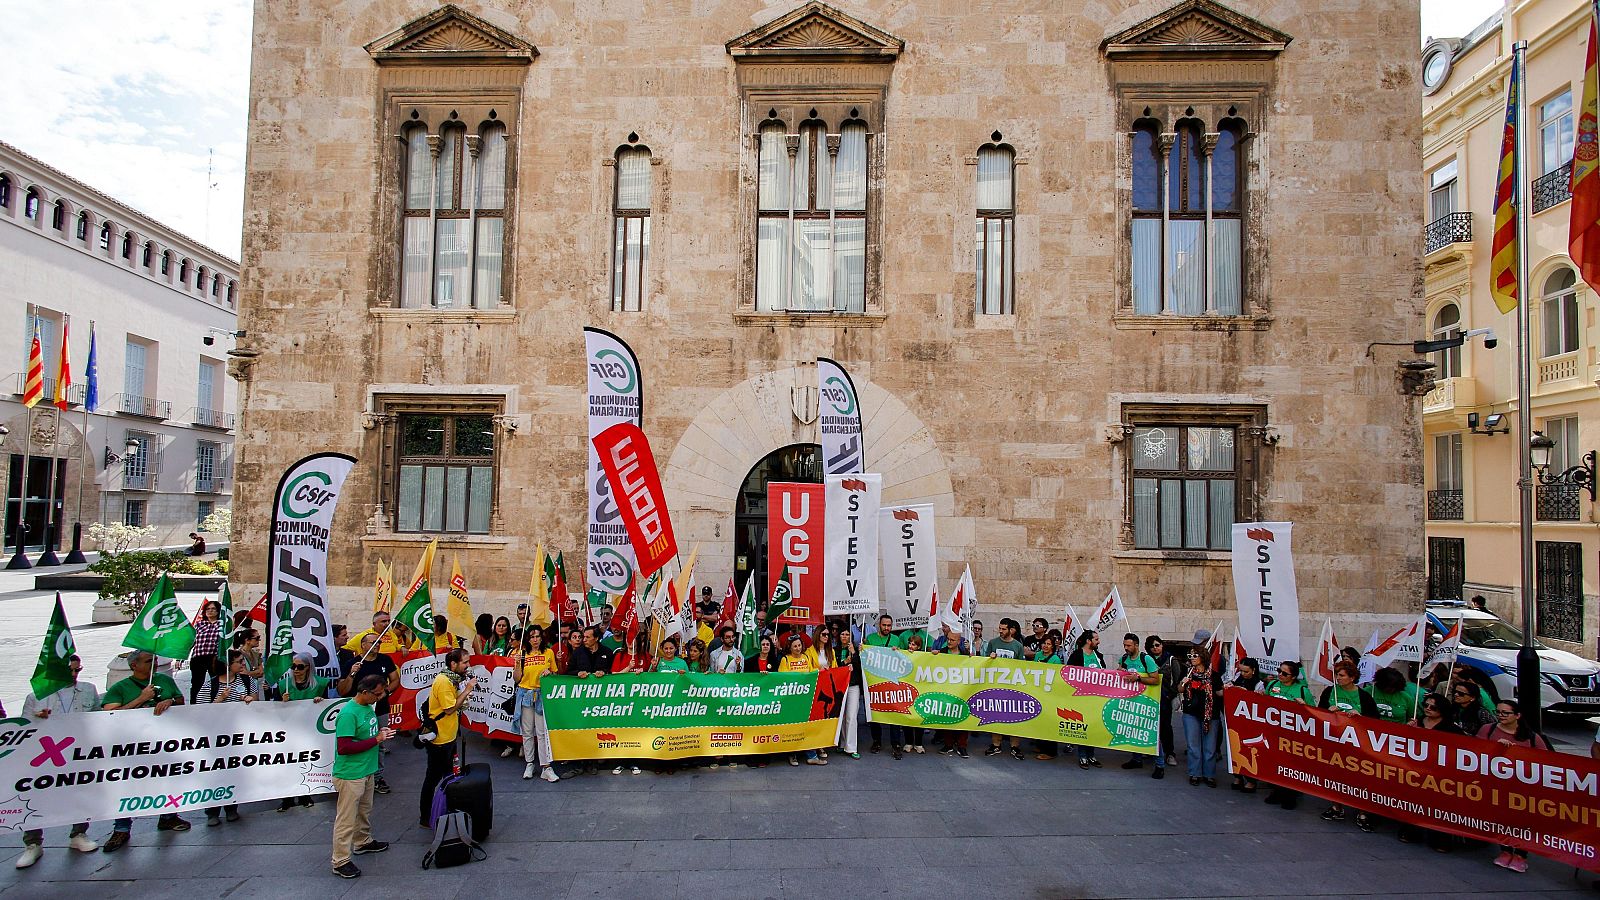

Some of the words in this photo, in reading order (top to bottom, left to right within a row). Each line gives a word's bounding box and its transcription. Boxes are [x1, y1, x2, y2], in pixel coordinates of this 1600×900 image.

[295, 485, 335, 507] CSIF
[610, 436, 662, 545] CCOO
[782, 492, 810, 599] UGT
[847, 494, 860, 597] STEPV
[901, 523, 919, 614] STEPV
[1257, 544, 1276, 656] STEPV
[401, 660, 446, 676] infraestr
[914, 665, 1056, 692] MOBILITZA'T!
[546, 685, 566, 699] JA
[605, 684, 625, 698] HA
[629, 683, 675, 698] PROU!
[681, 683, 760, 698] -burocràcia
[768, 682, 810, 696] -ràtios
[581, 702, 634, 717] +salari
[641, 701, 708, 719] +plantilla
[716, 701, 782, 716] +valencià
[918, 699, 963, 718] +SALARI
[971, 699, 1035, 714] +PLANTILLES
[1118, 697, 1157, 717] CENTRES
[1059, 721, 1088, 731] STEPV
[1111, 710, 1159, 731] EDUCATIUS
[0, 729, 38, 746] SIF
[752, 735, 771, 743] UGT
[1116, 724, 1150, 742] DIGNES
[30, 735, 76, 768] X
[73, 746, 105, 760] LA
[111, 736, 210, 759] MEJORA
[215, 734, 245, 748] DE
[248, 730, 287, 745] LAS
[1234, 700, 1316, 737] ALCEM
[1323, 721, 1360, 748] LA
[1367, 729, 1429, 762] VEU
[1438, 744, 1447, 767] I
[1456, 748, 1597, 796] DIGUEM
[15, 759, 196, 793] CONDICIONES
[199, 749, 322, 773] LABORALES
[1278, 736, 1483, 802] RECLASSIFICACIÓ
[1491, 788, 1499, 806] I
[1277, 765, 1322, 787] PERSONAL
[1324, 778, 1368, 800] D'ATENCIÓ
[1371, 792, 1424, 816] EDUCATIVA
[1434, 808, 1532, 841] D'ADMINISTRACIÓ
[1543, 834, 1595, 858] SERVEIS
